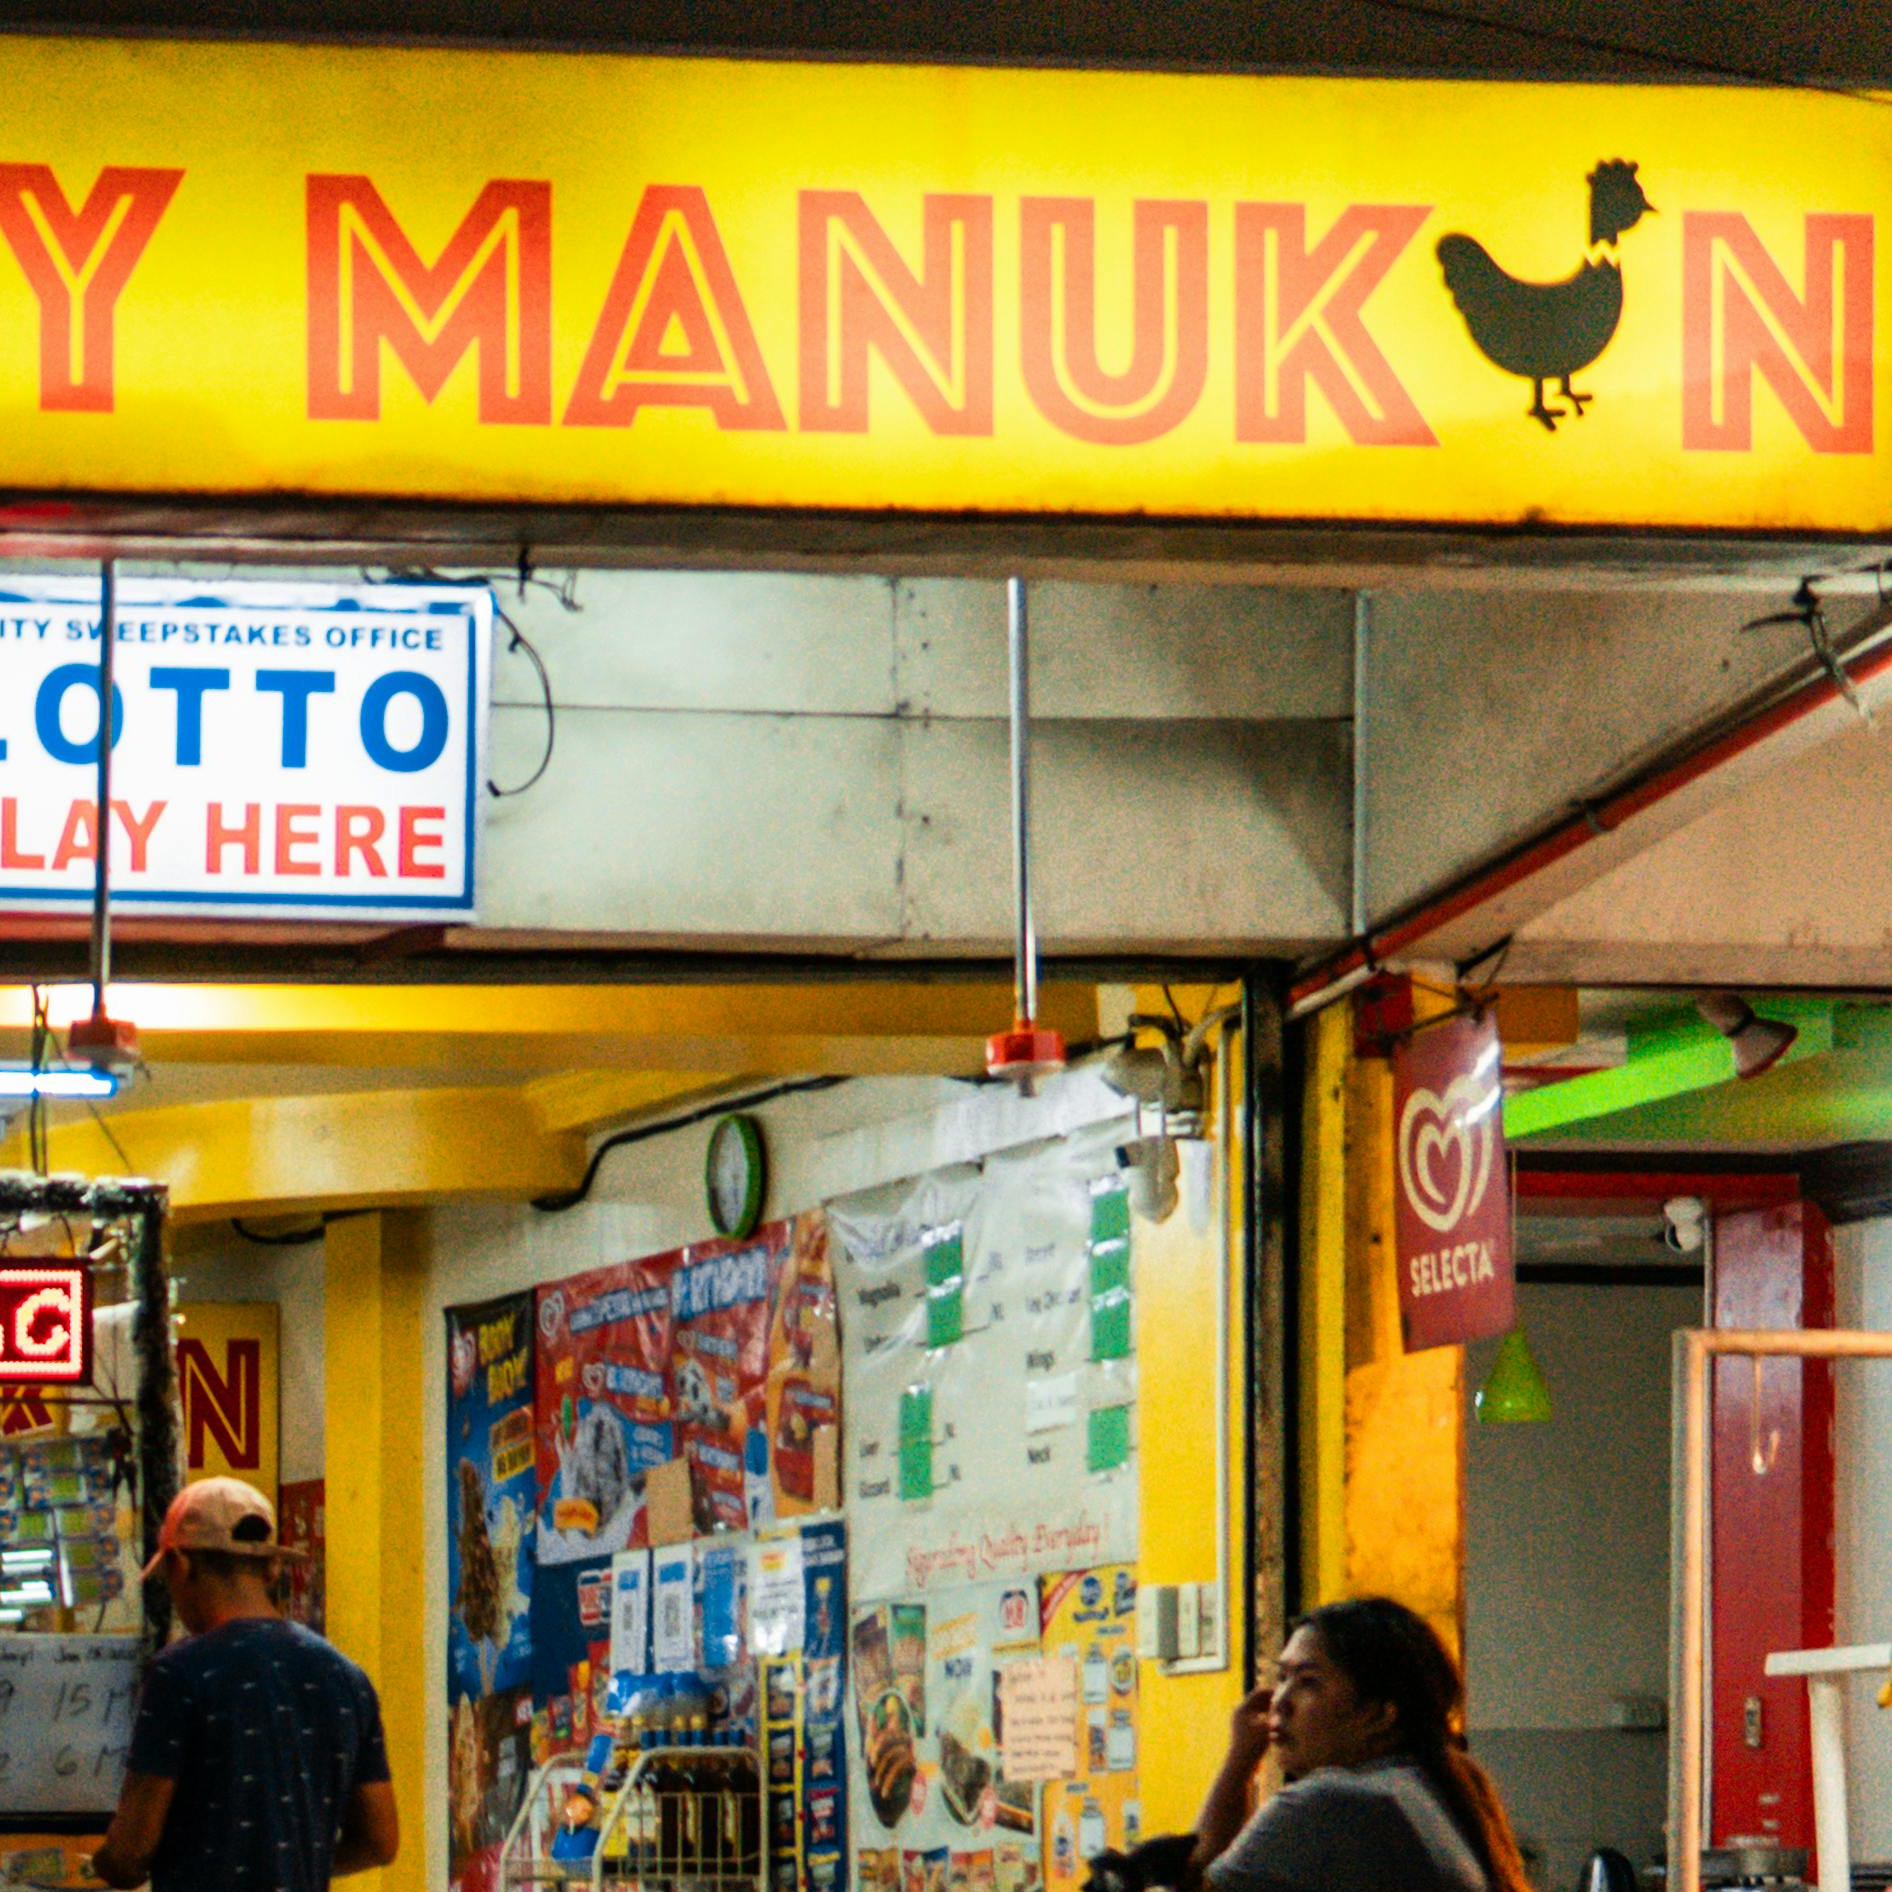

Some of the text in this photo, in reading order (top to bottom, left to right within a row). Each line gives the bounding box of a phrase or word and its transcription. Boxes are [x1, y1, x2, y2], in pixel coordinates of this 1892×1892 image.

[324, 622, 446, 652] OFFICE
[206, 802, 447, 881] HERE
[1409, 1239, 1495, 1299] SELECTA
